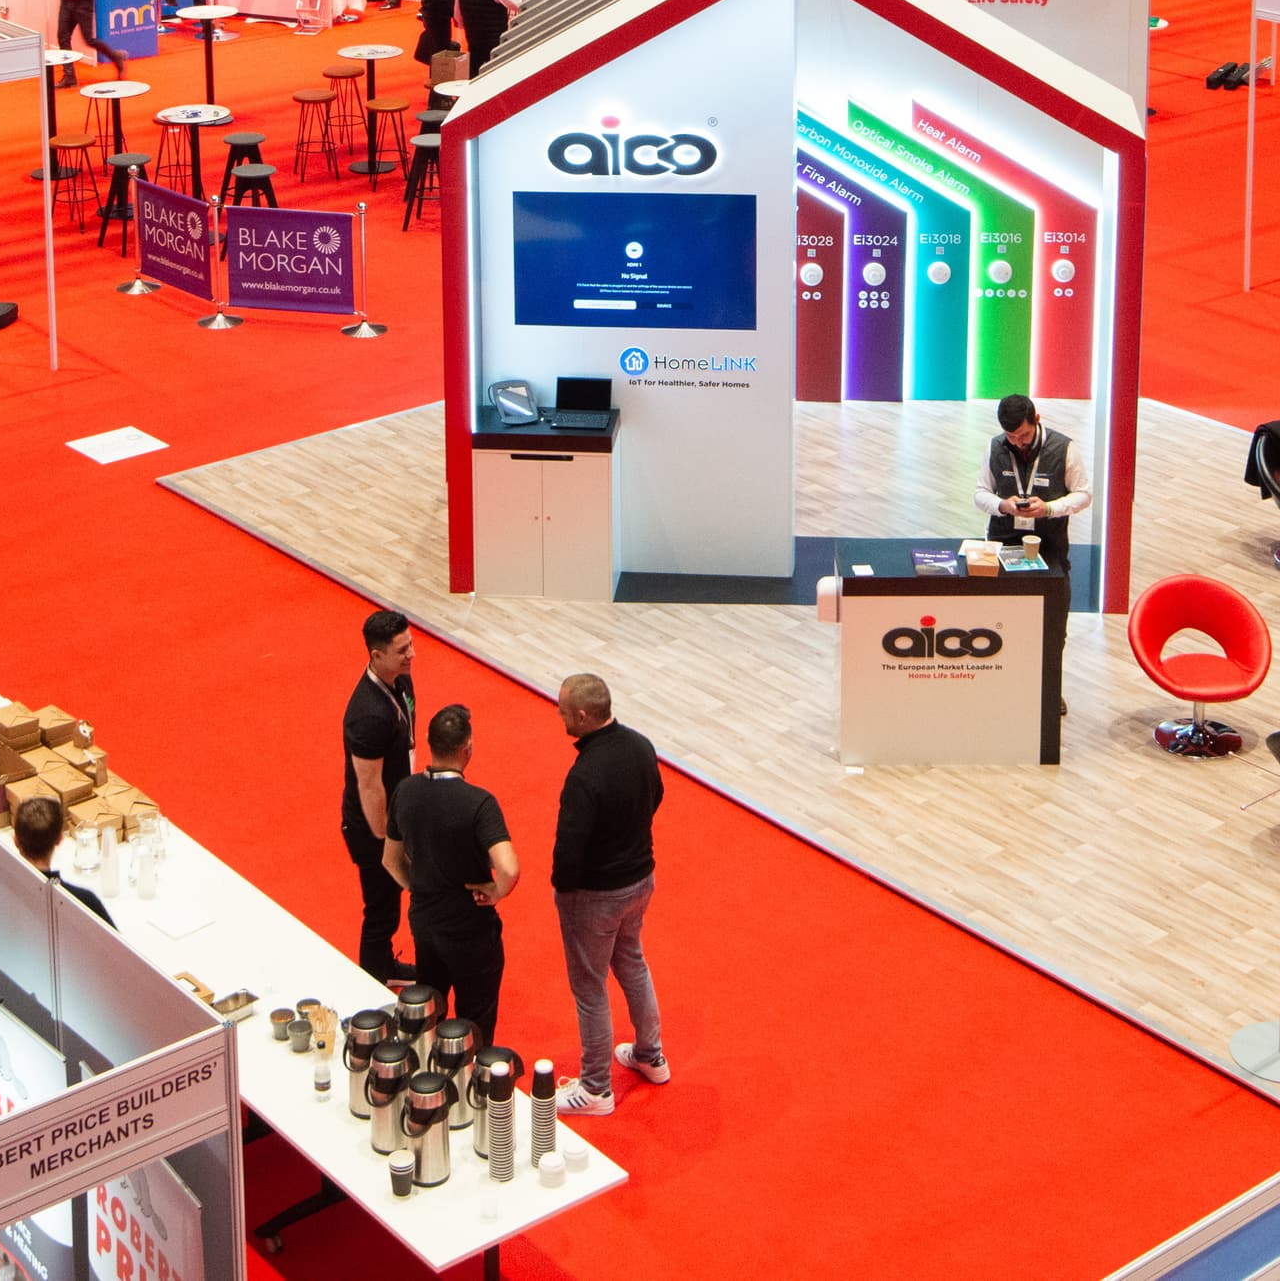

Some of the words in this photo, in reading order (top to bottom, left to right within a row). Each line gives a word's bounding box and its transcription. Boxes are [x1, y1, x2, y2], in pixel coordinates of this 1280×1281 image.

[109, 0, 156, 30] mri
[547, 115, 718, 176] aico
[916, 118, 946, 143] Heat
[944, 134, 983, 164] Alarm
[851, 119, 894, 151] Optical
[895, 142, 936, 175] Smoke
[934, 165, 971, 196] Alarm
[802, 164, 826, 184] Fire
[825, 180, 863, 206] Alarm
[832, 142, 888, 182] Monoxide
[888, 173, 925, 204] Alarm
[144, 201, 185, 232] BLAKE
[144, 226, 204, 262] MORGAN
[239, 228, 307, 250] BLAKE
[853, 235, 898, 247] Ei3024
[920, 233, 962, 245] Ei3018
[980, 233, 1022, 244] Ei3016
[1044, 232, 1086, 244] Ei3014
[147, 253, 205, 280] www.blakemorgan.co.uk
[239, 252, 342, 276] MORGAN
[630, 272, 648, 281] Signal
[241, 281, 341, 295] www.blakemorgan.co.uk
[654, 355, 758, 372] HomeLINK
[657, 379, 697, 389] Healthier,
[698, 380, 720, 388] Safer
[721, 381, 750, 389] Homes
[882, 615, 1003, 658] aico
[897, 664, 936, 672] European
[950, 672, 976, 681] Safety
[51, 1106, 111, 1148] PRICE
[117, 1062, 218, 1120] BUILDERS'
[30, 1113, 155, 1180] MERCHANTS
